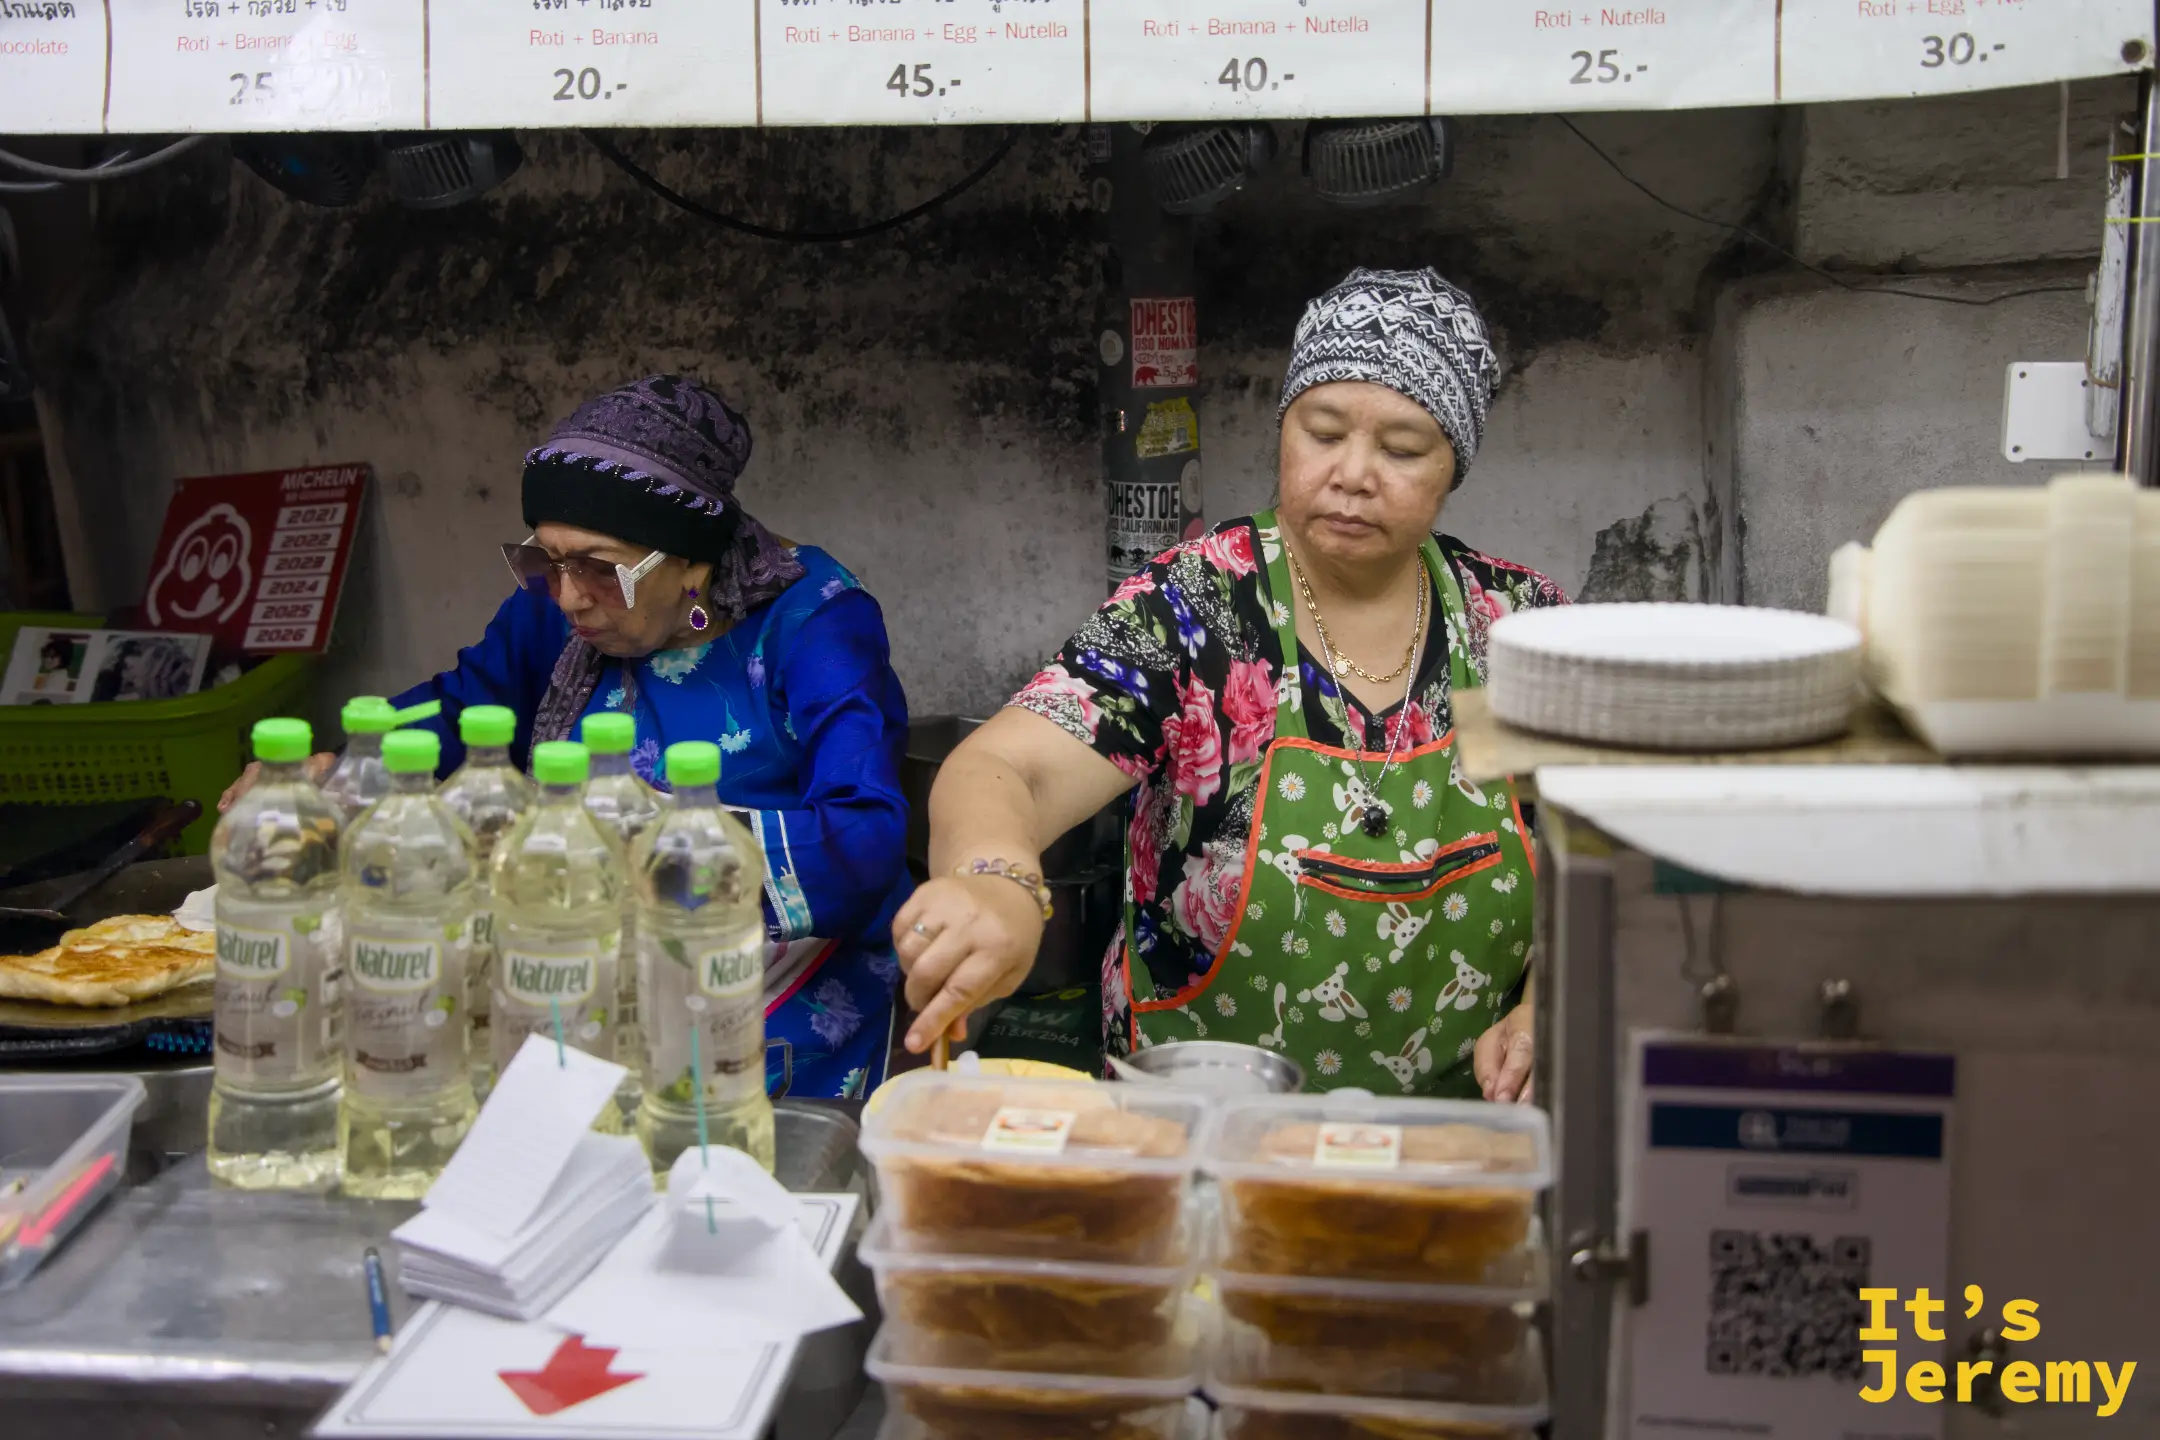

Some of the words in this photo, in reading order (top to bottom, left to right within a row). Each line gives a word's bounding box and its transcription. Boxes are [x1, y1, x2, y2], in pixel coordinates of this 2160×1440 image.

[1535, 9, 1572, 28] Roti
[1601, 8, 1666, 26] Nutella
[1858, 0, 1896, 18] Roti
[785, 26, 820, 44] Roti
[849, 25, 915, 42] Banana
[943, 23, 977, 43] Egg
[1005, 21, 1068, 39] Nutella
[1143, 19, 1179, 36] Roti
[1208, 18, 1276, 36] Banana
[1305, 15, 1369, 34] Nutella
[177, 35, 210, 51] Roti
[529, 29, 565, 46] Roti
[592, 28, 659, 46] Banana
[1920, 32, 2006, 68] 30.-
[1218, 56, 1296, 93] 40.-
[1569, 48, 1649, 85] 25.-
[552, 66, 628, 101] 20.-
[886, 62, 962, 99] 45.-
[281, 467, 358, 490] MICHELIN
[286, 507, 338, 524] 2021
[280, 532, 333, 548] 2022
[274, 556, 326, 571] 2023
[268, 580, 320, 595] 2024
[261, 604, 314, 619] 2025
[255, 628, 308, 643] 2026
[356, 942, 433, 981] Naturel
[508, 956, 590, 994] Naturel
